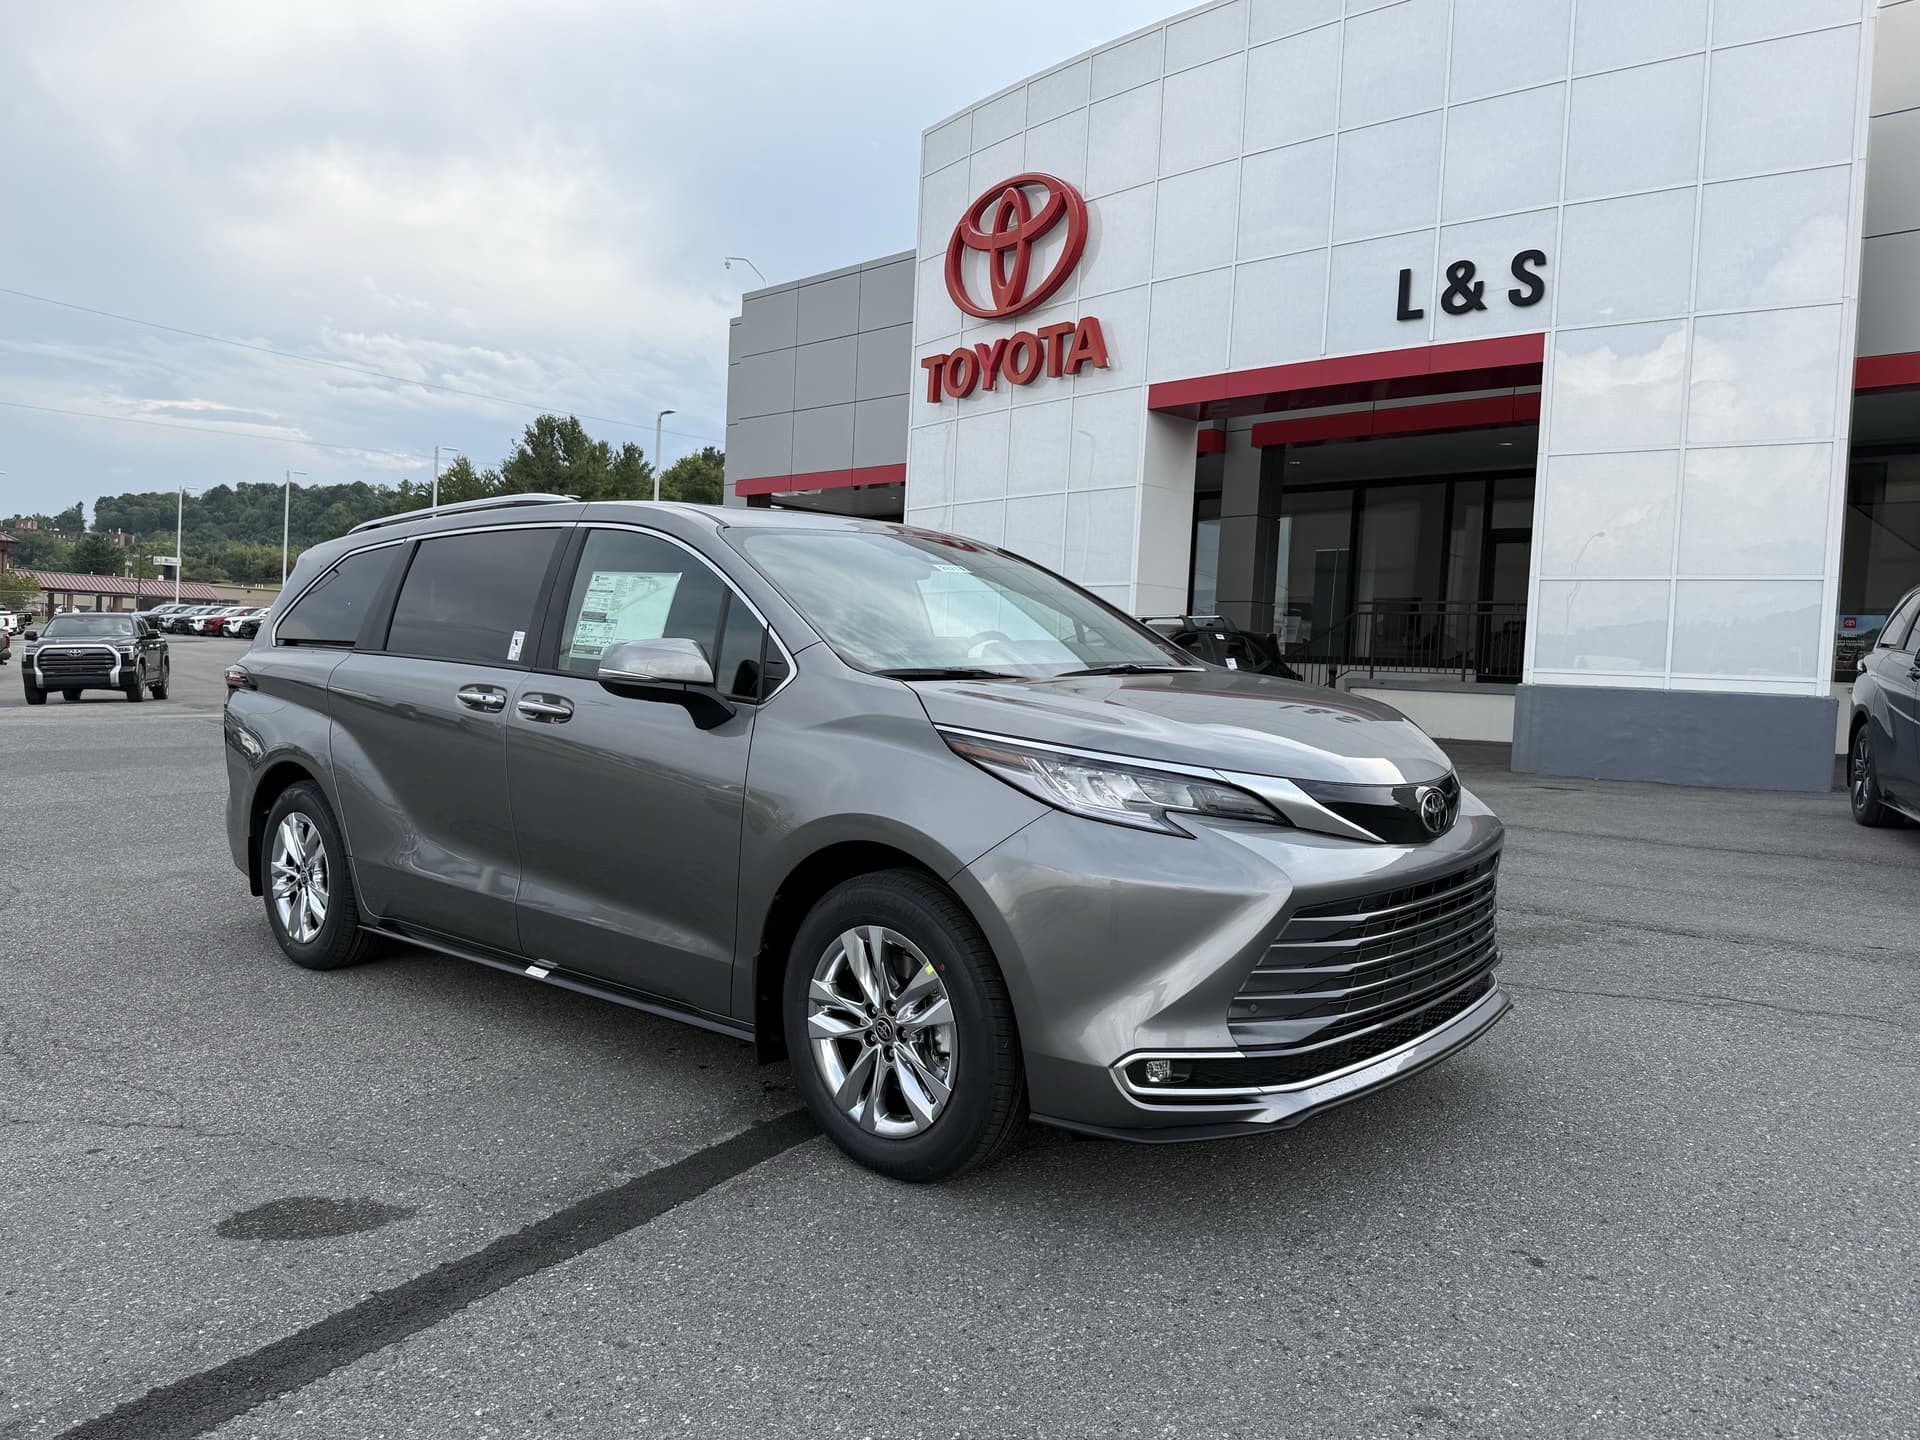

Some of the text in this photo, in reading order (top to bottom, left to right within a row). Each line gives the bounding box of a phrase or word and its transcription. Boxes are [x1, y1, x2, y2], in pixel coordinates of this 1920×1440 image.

[1396, 249, 1547, 322] L & S
[921, 317, 1110, 403] TOYOTA
